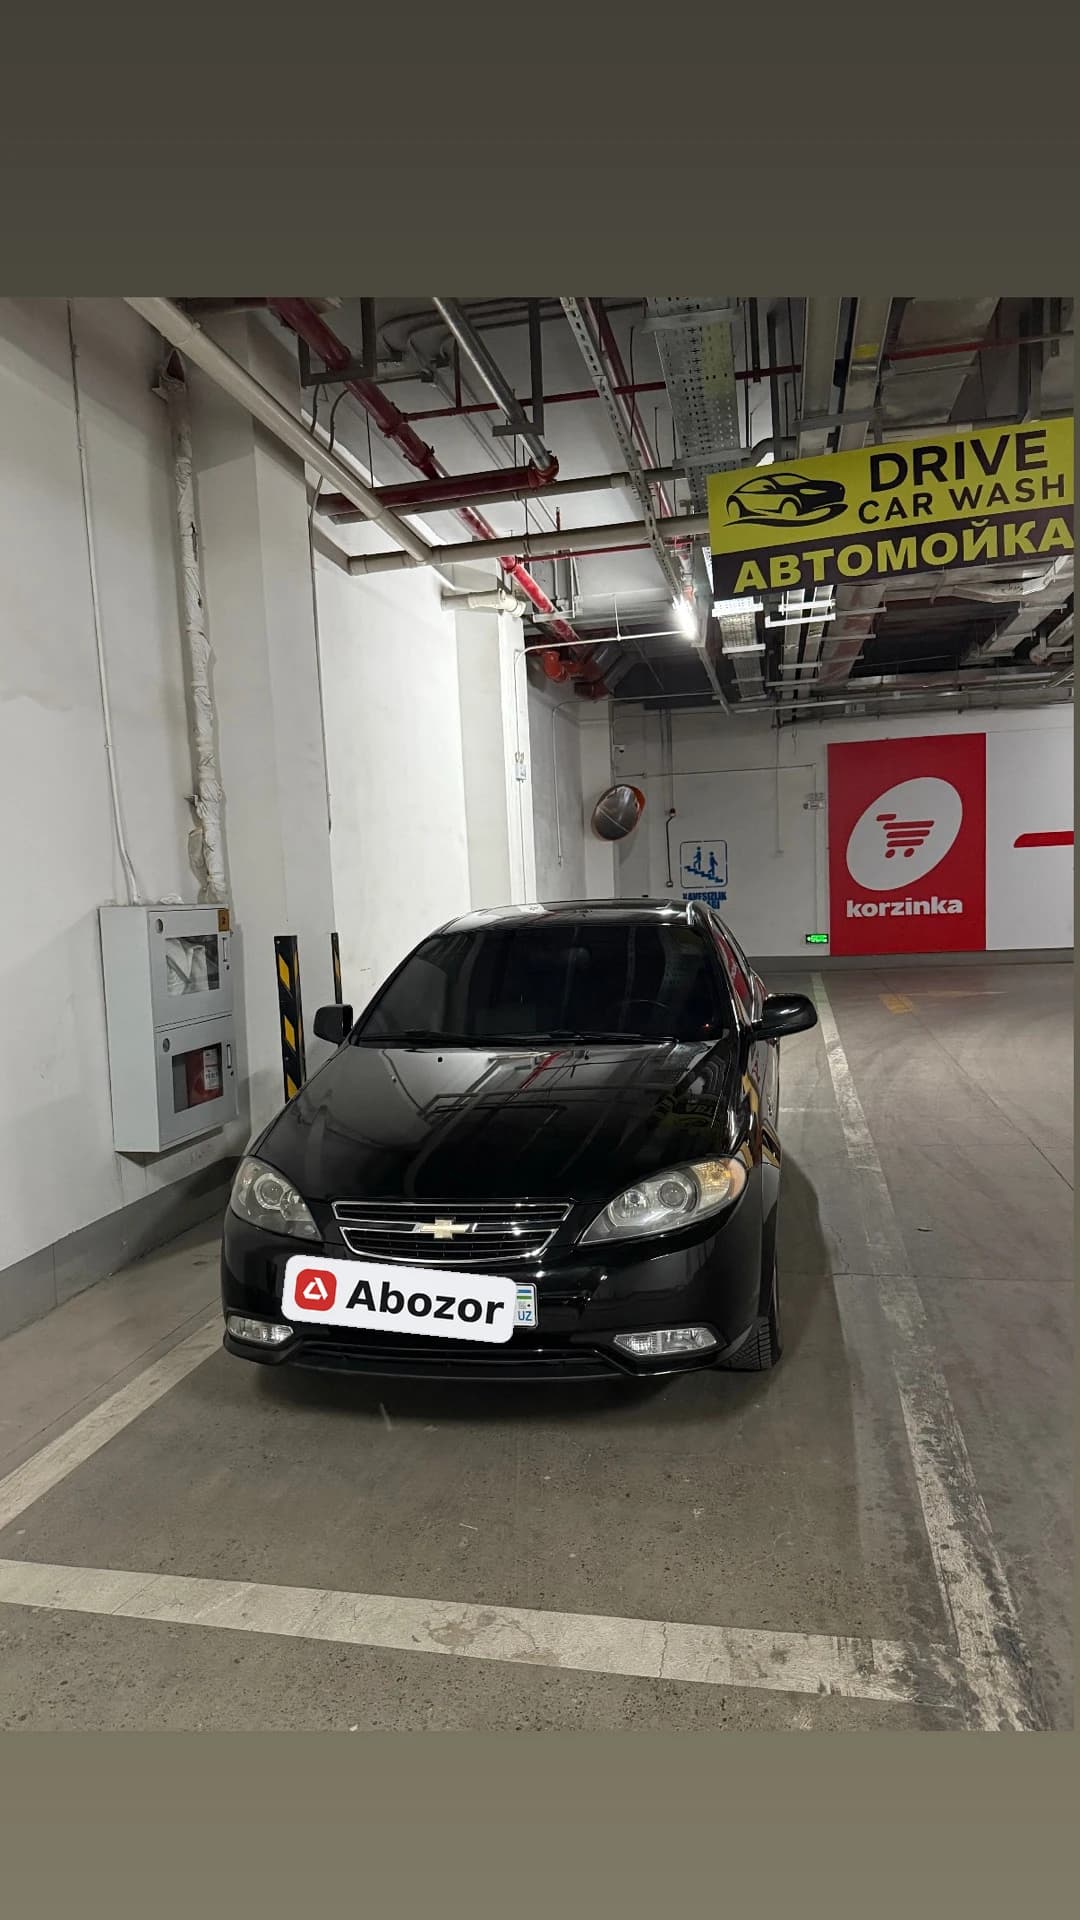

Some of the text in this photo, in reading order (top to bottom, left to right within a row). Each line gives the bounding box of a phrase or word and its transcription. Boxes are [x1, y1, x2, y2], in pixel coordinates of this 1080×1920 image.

[869, 429, 1048, 492] DRIVE
[858, 473, 1065, 525] CAR WASH
[733, 517, 1074, 594] АВТОМОЙКА
[846, 896, 963, 919] korzinka
[517, 1310, 533, 1322] UZ
